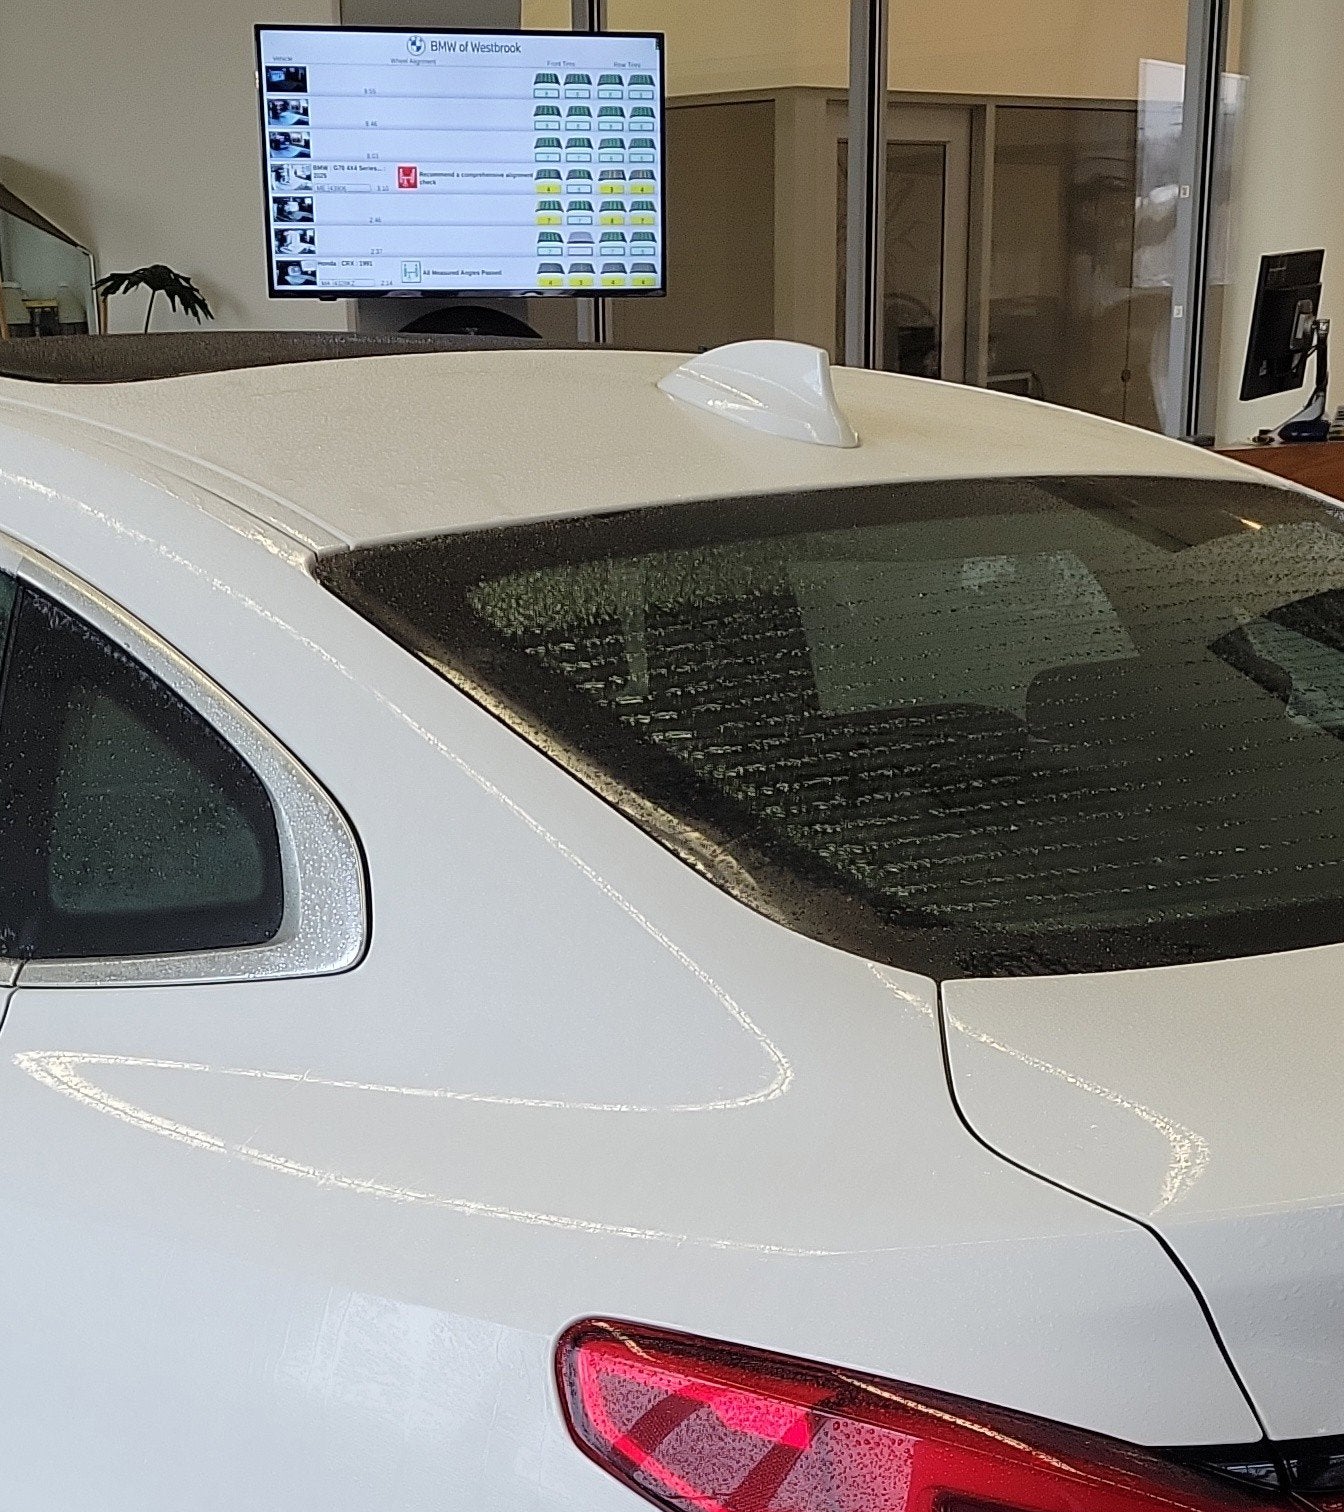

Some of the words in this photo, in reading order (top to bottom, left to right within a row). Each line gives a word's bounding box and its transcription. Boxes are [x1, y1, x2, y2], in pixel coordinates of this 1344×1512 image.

[430, 41, 456, 52] BMW
[459, 41, 469, 52] of
[471, 41, 521, 54] Westbrook
